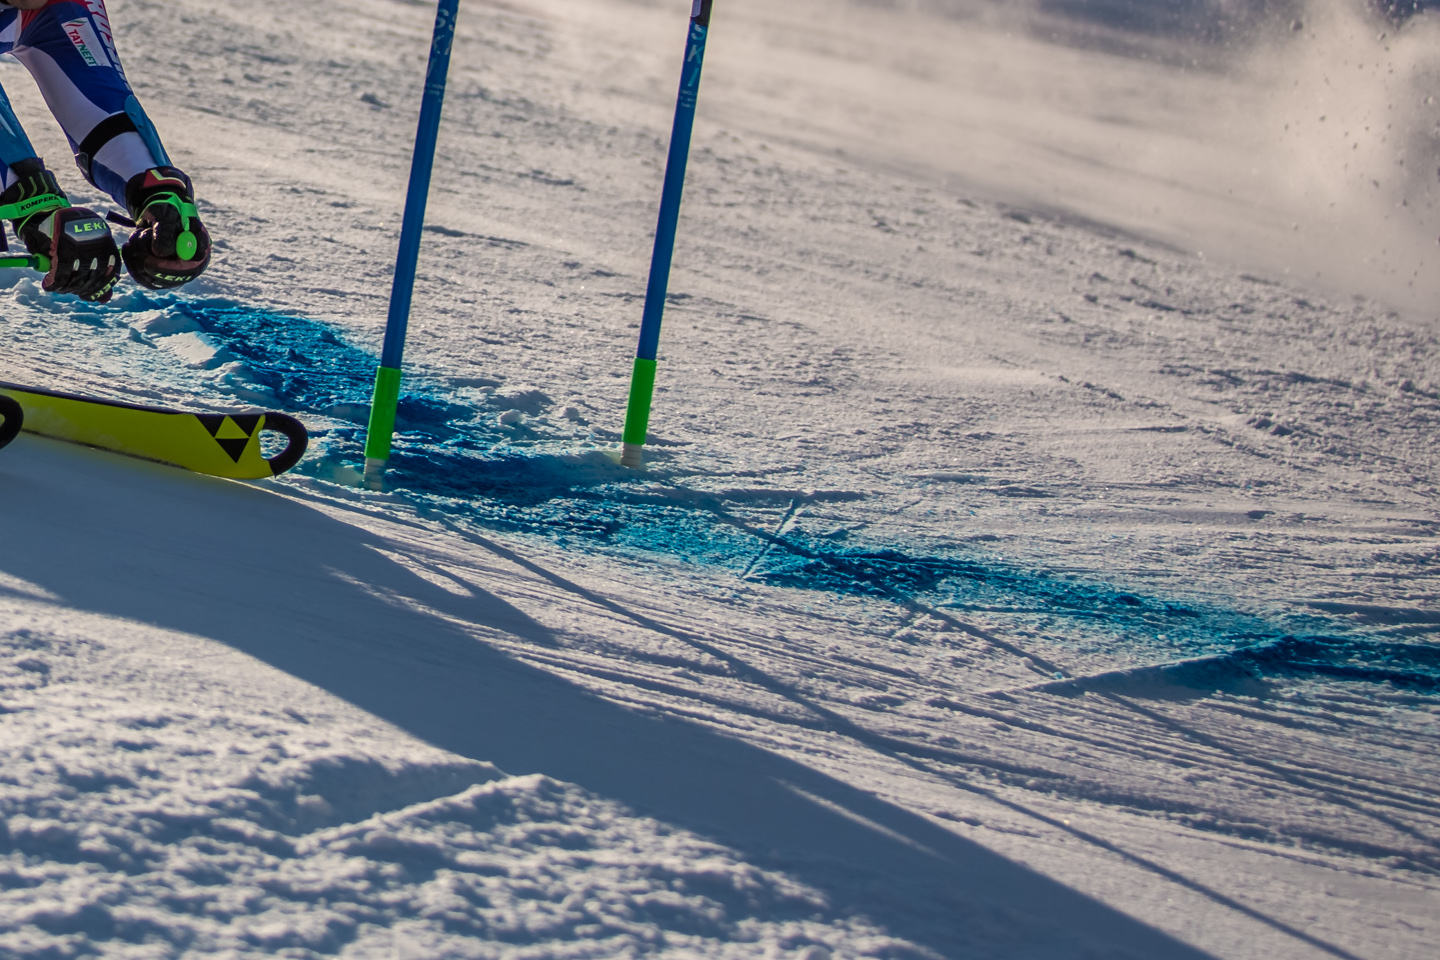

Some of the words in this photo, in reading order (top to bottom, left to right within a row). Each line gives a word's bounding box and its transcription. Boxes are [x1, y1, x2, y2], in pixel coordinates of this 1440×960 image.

[67, 29, 97, 66] TATNEFT
[74, 222, 107, 233] LEKI
[155, 273, 192, 282] LEKI
[90, 276, 118, 300] LEKI
